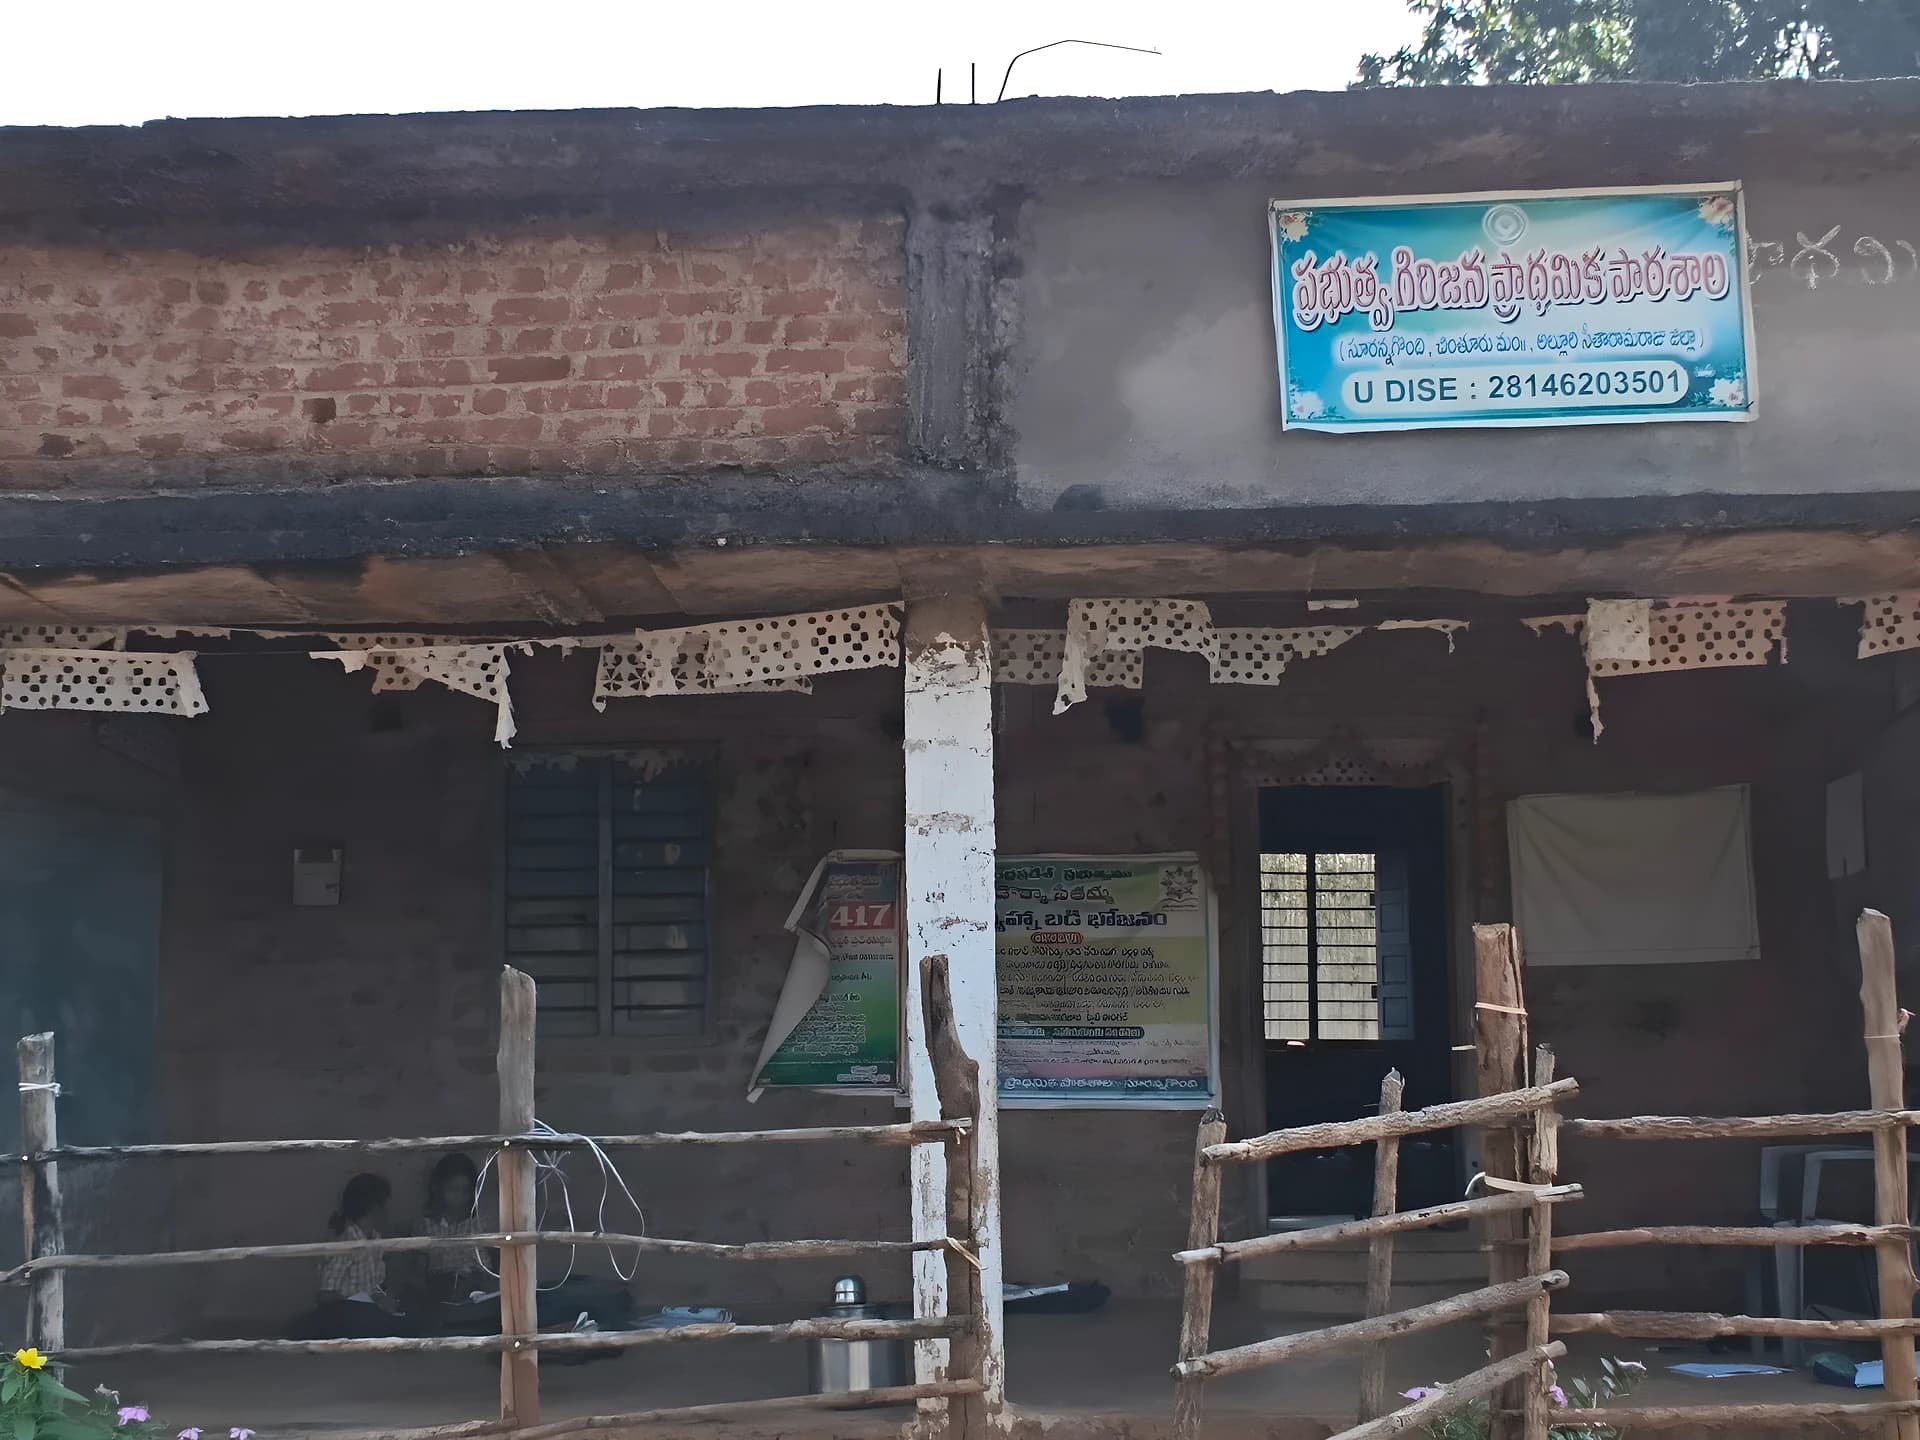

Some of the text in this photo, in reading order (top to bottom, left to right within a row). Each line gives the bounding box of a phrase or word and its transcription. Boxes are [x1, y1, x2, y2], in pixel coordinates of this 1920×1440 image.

[1293, 254, 1389, 327] ప్రభుత్వ
[1395, 249, 1486, 307] గిరిజన
[1608, 245, 1727, 298] పాఠశాల
[1354, 380, 1373, 403] U
[1386, 377, 1458, 402] DISE
[1488, 369, 1679, 399] 28146203501
[1044, 909, 1081, 927] బడి
[1087, 908, 1168, 929] భోజనం
